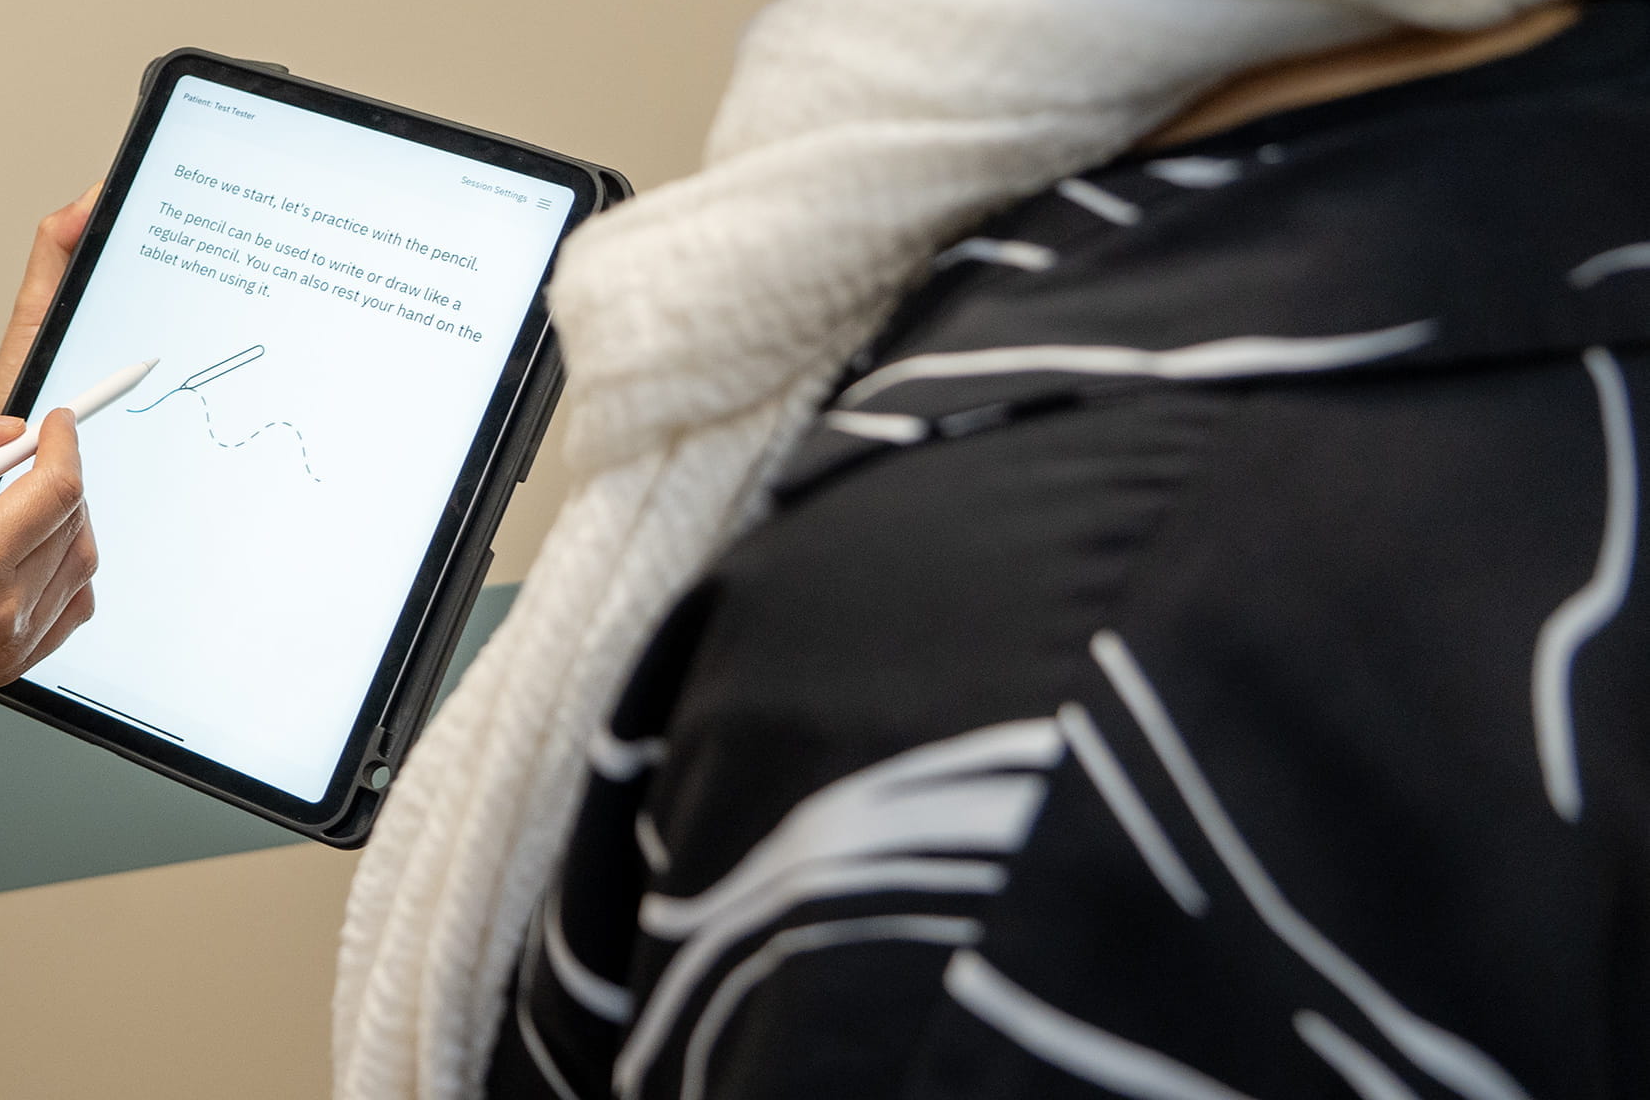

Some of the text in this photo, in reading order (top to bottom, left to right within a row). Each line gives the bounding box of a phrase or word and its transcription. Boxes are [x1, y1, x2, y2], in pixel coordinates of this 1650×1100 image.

[174, 164, 479, 271] Before we start, let's practice with the pencil.
[460, 175, 528, 203] Session Settings
[140, 244, 271, 298] tablet when using it.
[148, 225, 482, 342] regular pencil. You can also rest your hand on the
[159, 201, 461, 311] The pencil can be used to write or draw like a
